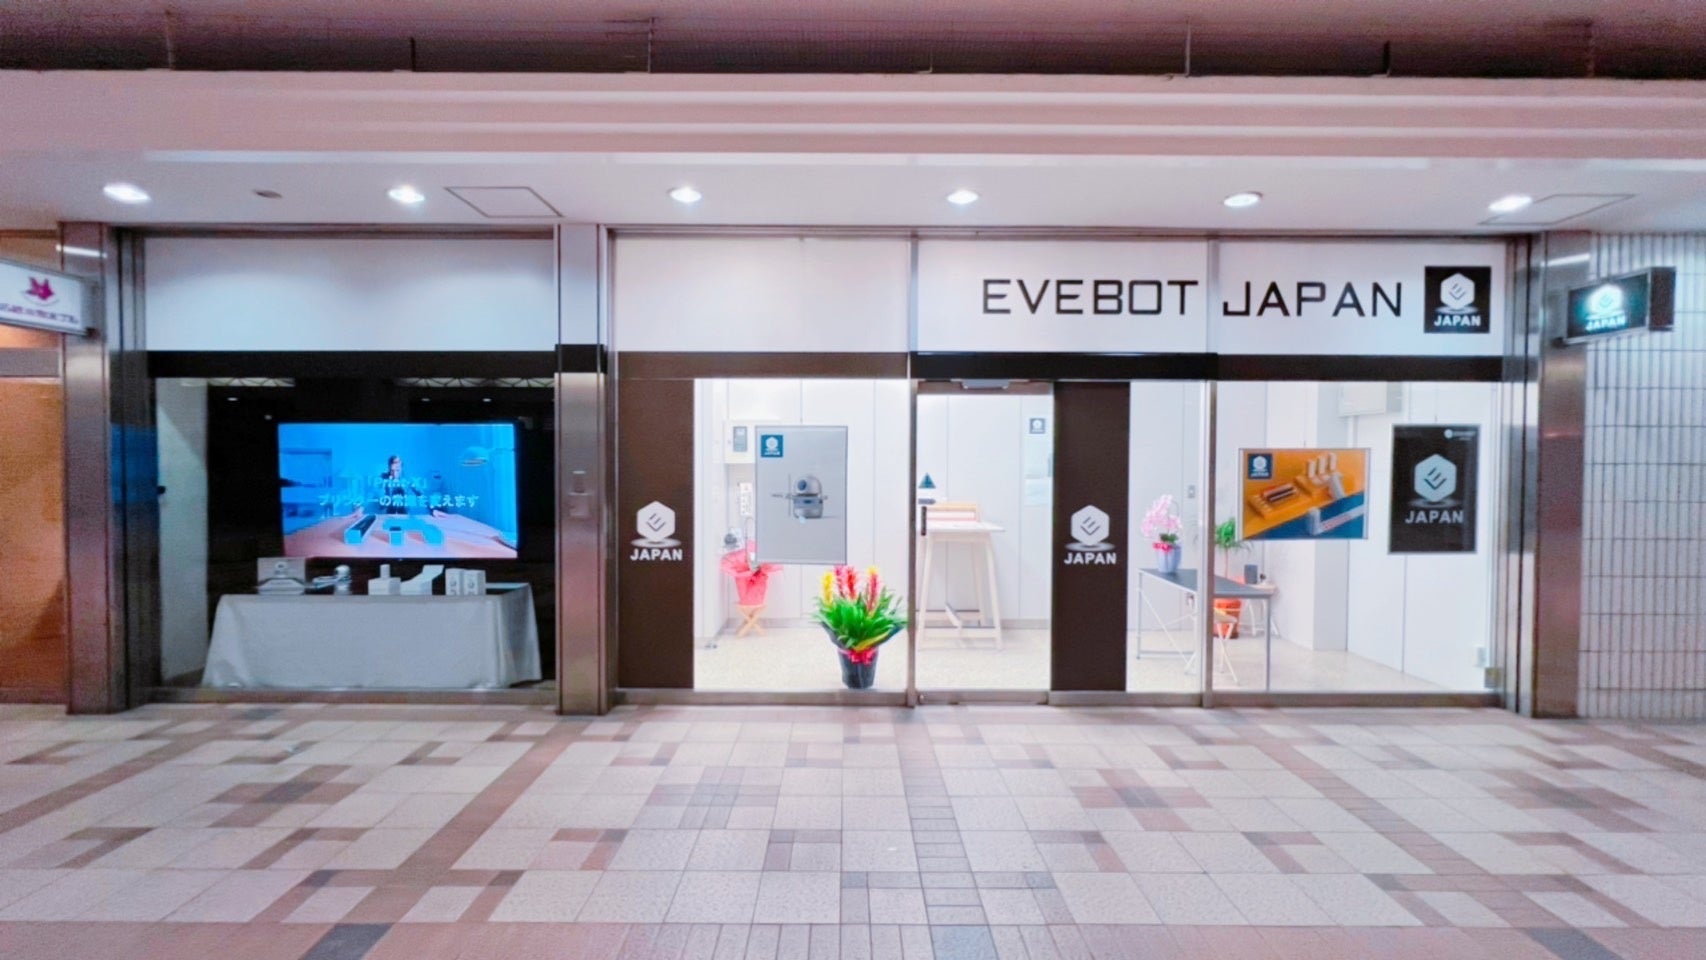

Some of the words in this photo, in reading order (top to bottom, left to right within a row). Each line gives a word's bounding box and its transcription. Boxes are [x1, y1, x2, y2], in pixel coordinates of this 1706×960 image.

[982, 279, 1199, 316] EVEBOT
[1222, 281, 1402, 317] JAPAN
[1433, 315, 1482, 327] JAPAN
[1585, 314, 1626, 332] JAPAN
[1404, 510, 1465, 524] JAPAN
[629, 548, 684, 561] JAPAN
[1063, 552, 1117, 565] JAPAN
